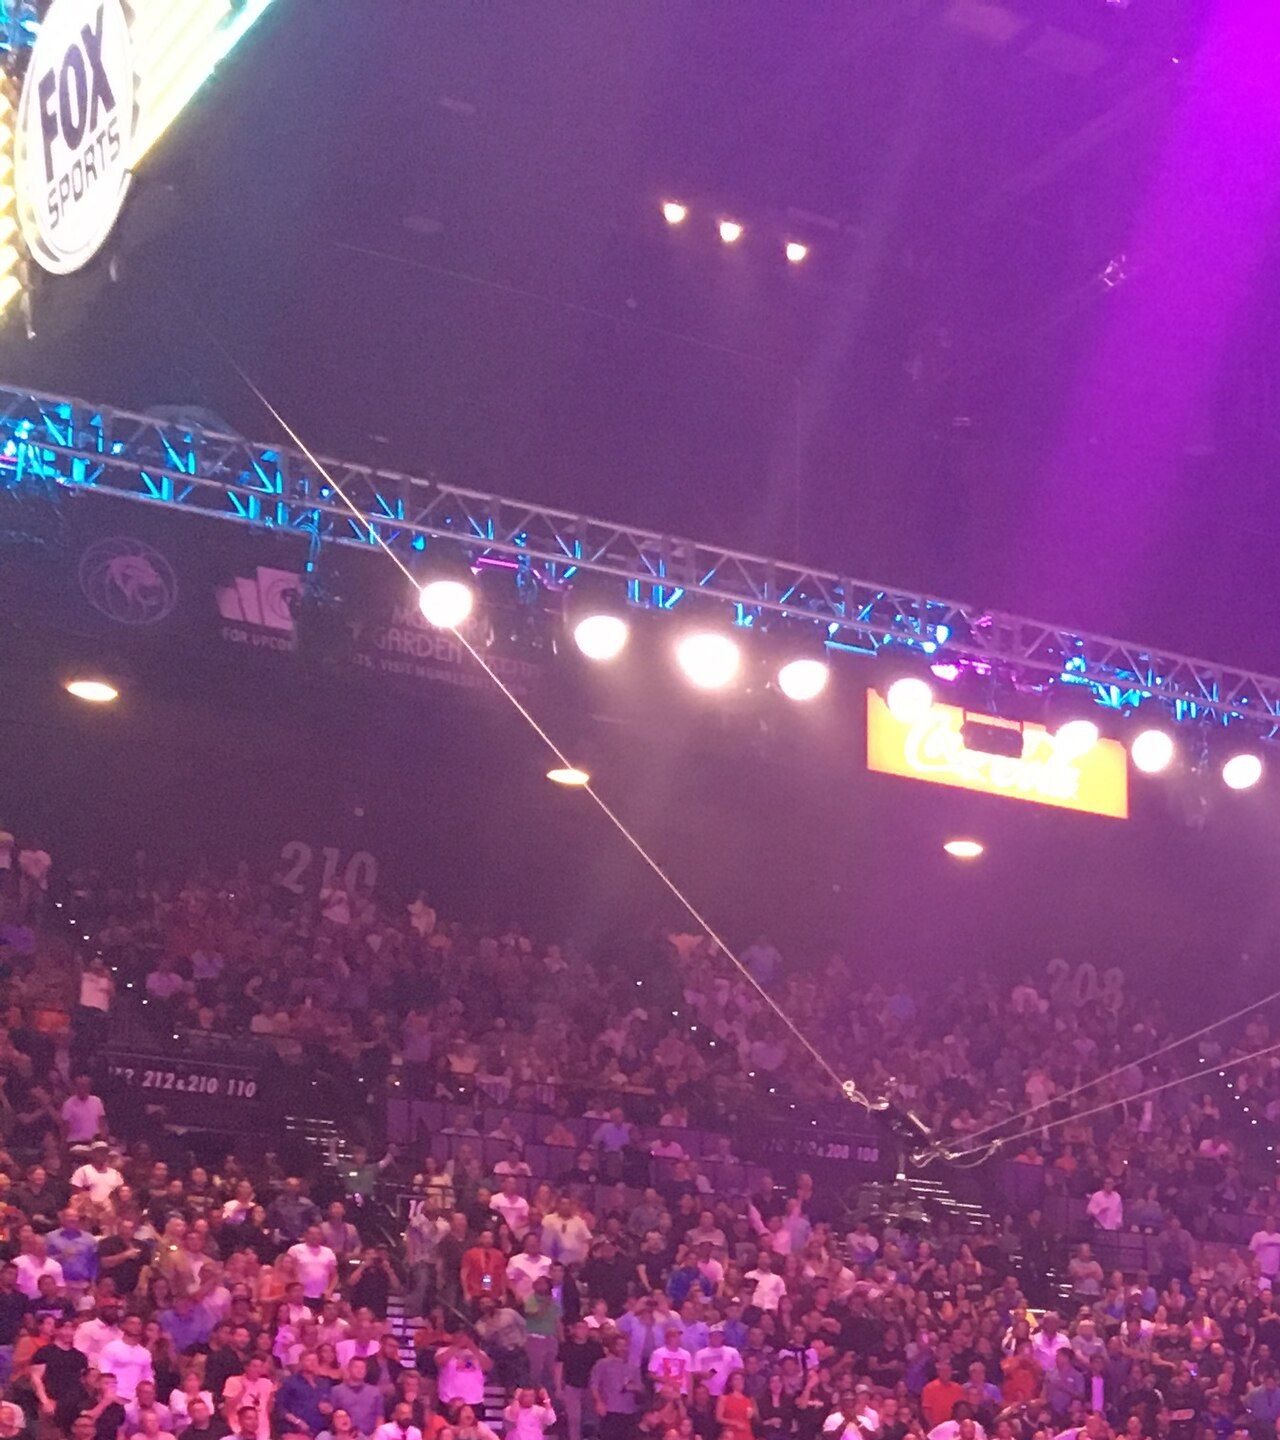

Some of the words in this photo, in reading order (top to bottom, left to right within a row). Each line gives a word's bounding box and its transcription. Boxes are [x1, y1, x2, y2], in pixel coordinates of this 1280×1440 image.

[38, 4, 116, 184] FOX
[47, 116, 121, 230] SPORTS
[280, 841, 378, 894] 210
[1046, 958, 1125, 1010] 208
[227, 1078, 258, 1099] 110
